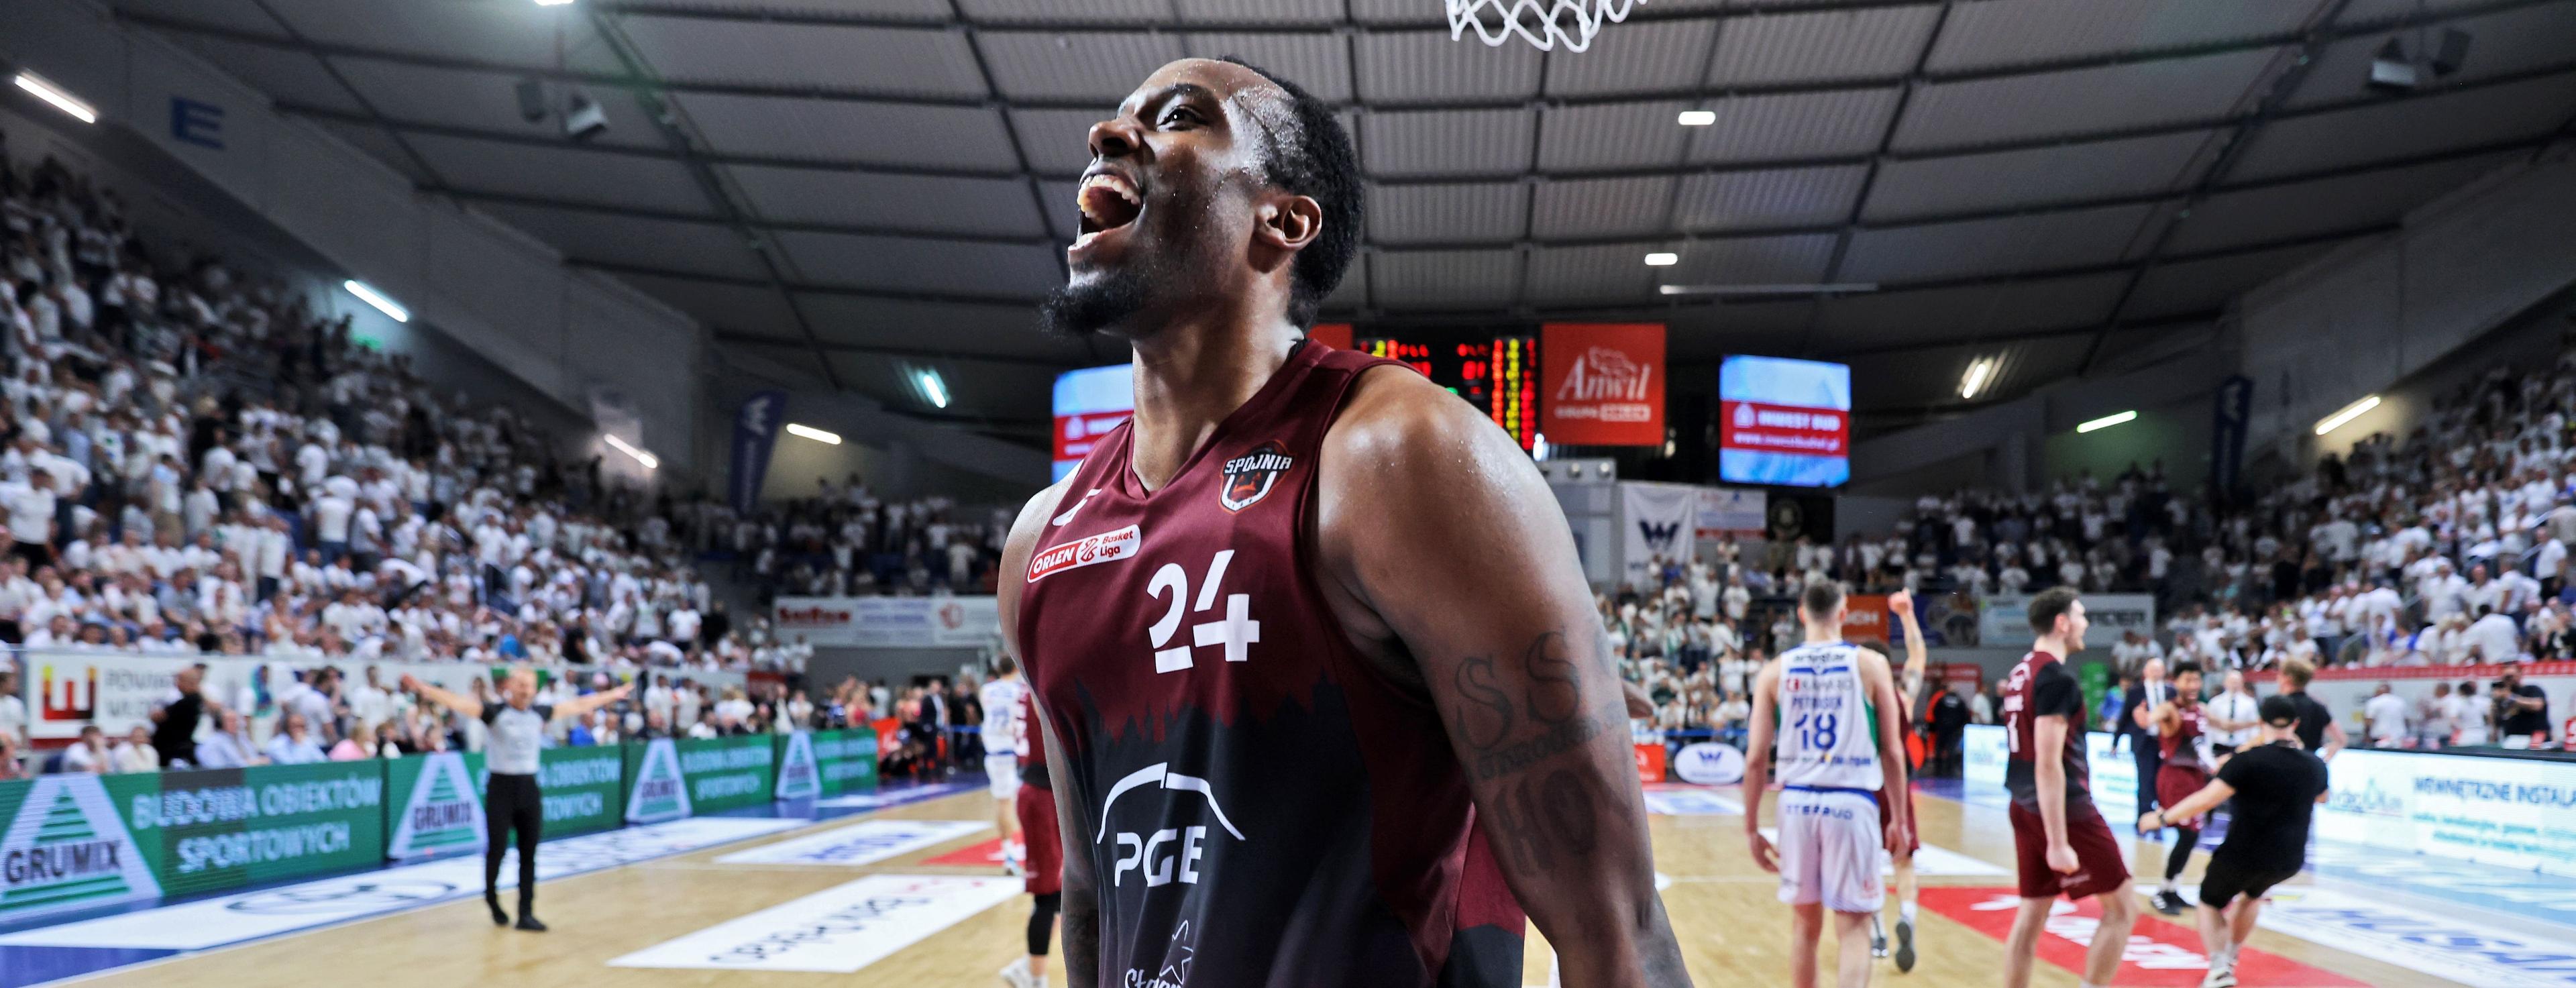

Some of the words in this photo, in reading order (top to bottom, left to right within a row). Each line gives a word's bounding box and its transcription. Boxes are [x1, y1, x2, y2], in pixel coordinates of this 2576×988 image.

[171, 97, 224, 150] E
[1556, 354, 1652, 401] Anwil
[1033, 547, 1075, 574] ORLEN
[1102, 531, 1134, 545] Basket
[1099, 545, 1121, 558] Liga
[1146, 549, 1260, 674] 24
[1794, 714, 1837, 751] 18
[131, 784, 259, 830] BUDOWA
[260, 773, 383, 818] OBIEKTÓW
[5, 839, 122, 885] GRUMIX
[176, 822, 351, 873] SPORTOWYCH
[1114, 826, 1206, 887] PGE
